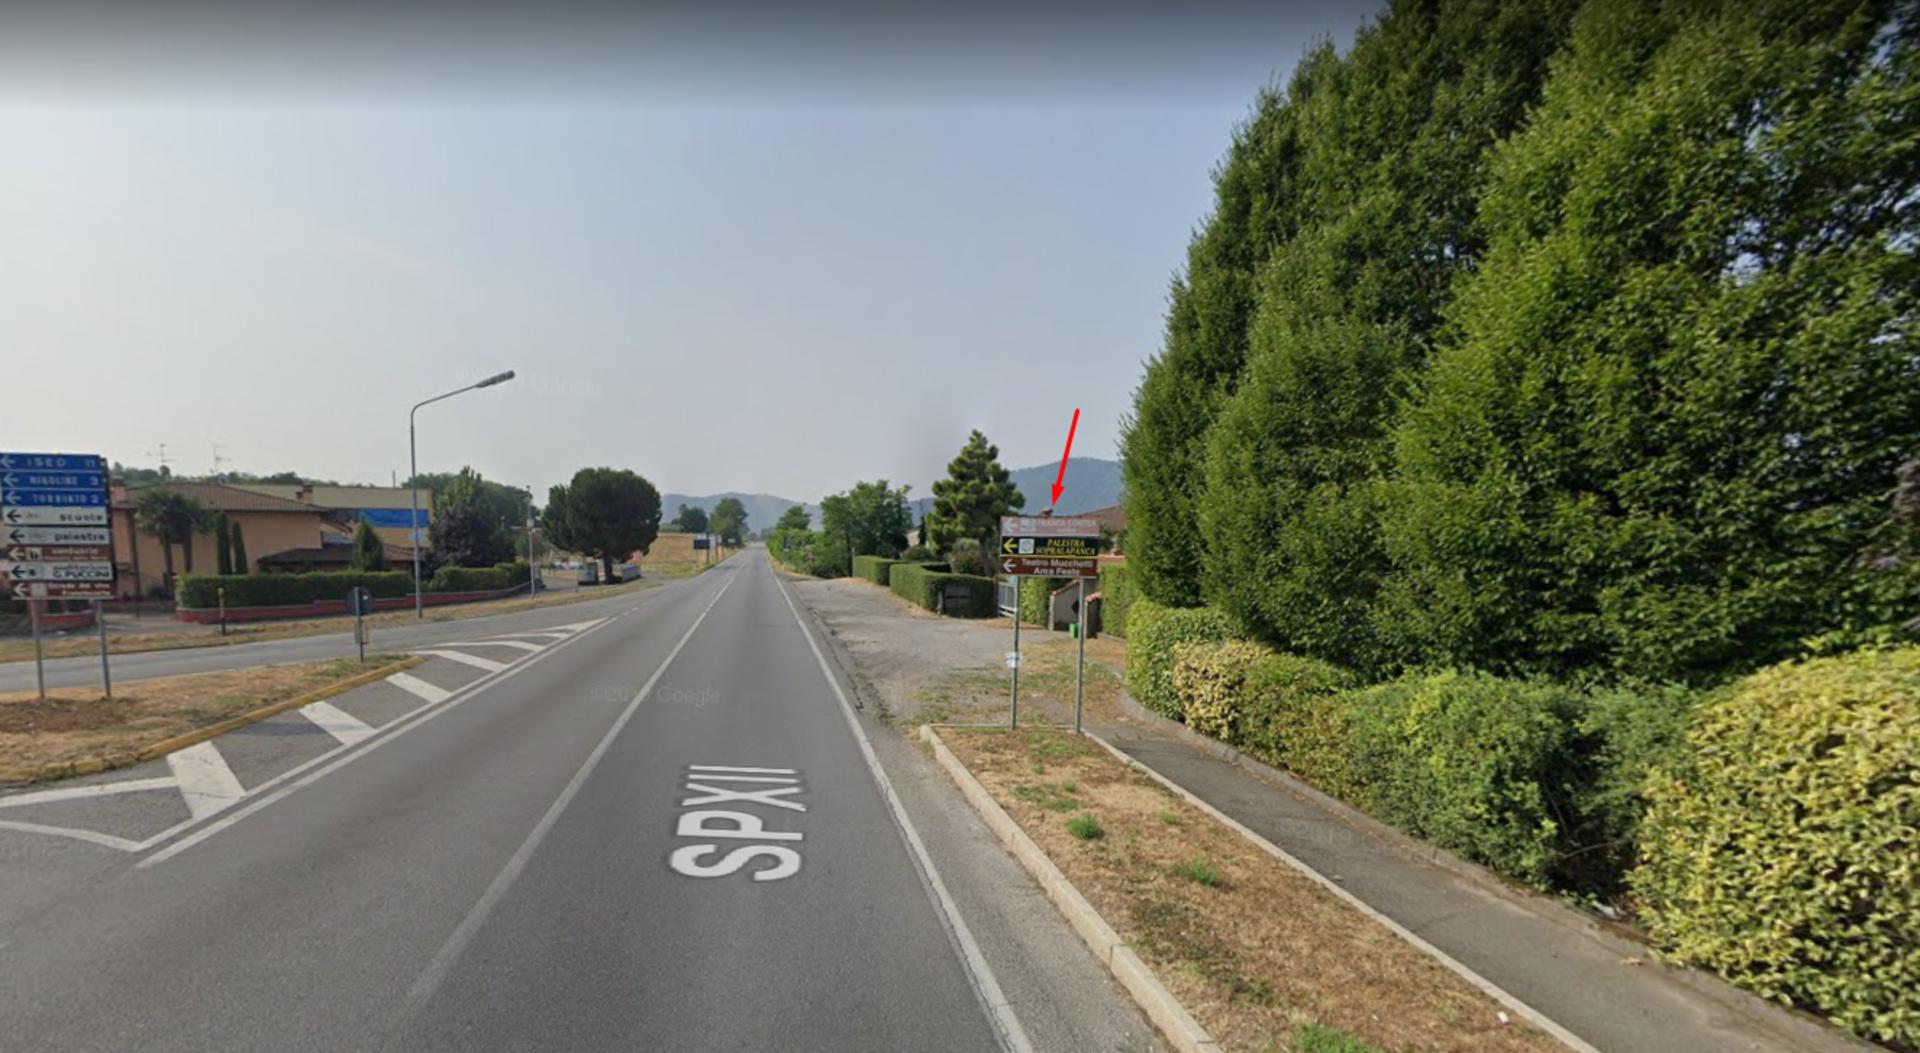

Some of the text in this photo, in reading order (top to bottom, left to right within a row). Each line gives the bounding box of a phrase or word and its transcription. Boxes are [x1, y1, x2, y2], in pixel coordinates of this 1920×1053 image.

[26, 457, 96, 468] ISEO 11
[59, 513, 103, 522] scuole
[54, 532, 106, 542] palestra
[1047, 539, 1085, 548] PALESTRA
[1035, 547, 1096, 556] SOPRALAPANCA
[1022, 559, 1094, 568] Teatro Mucchetti
[64, 570, 110, 578] PUCCINI
[1033, 567, 1055, 576] Area
[669, 765, 807, 882] SPXII
